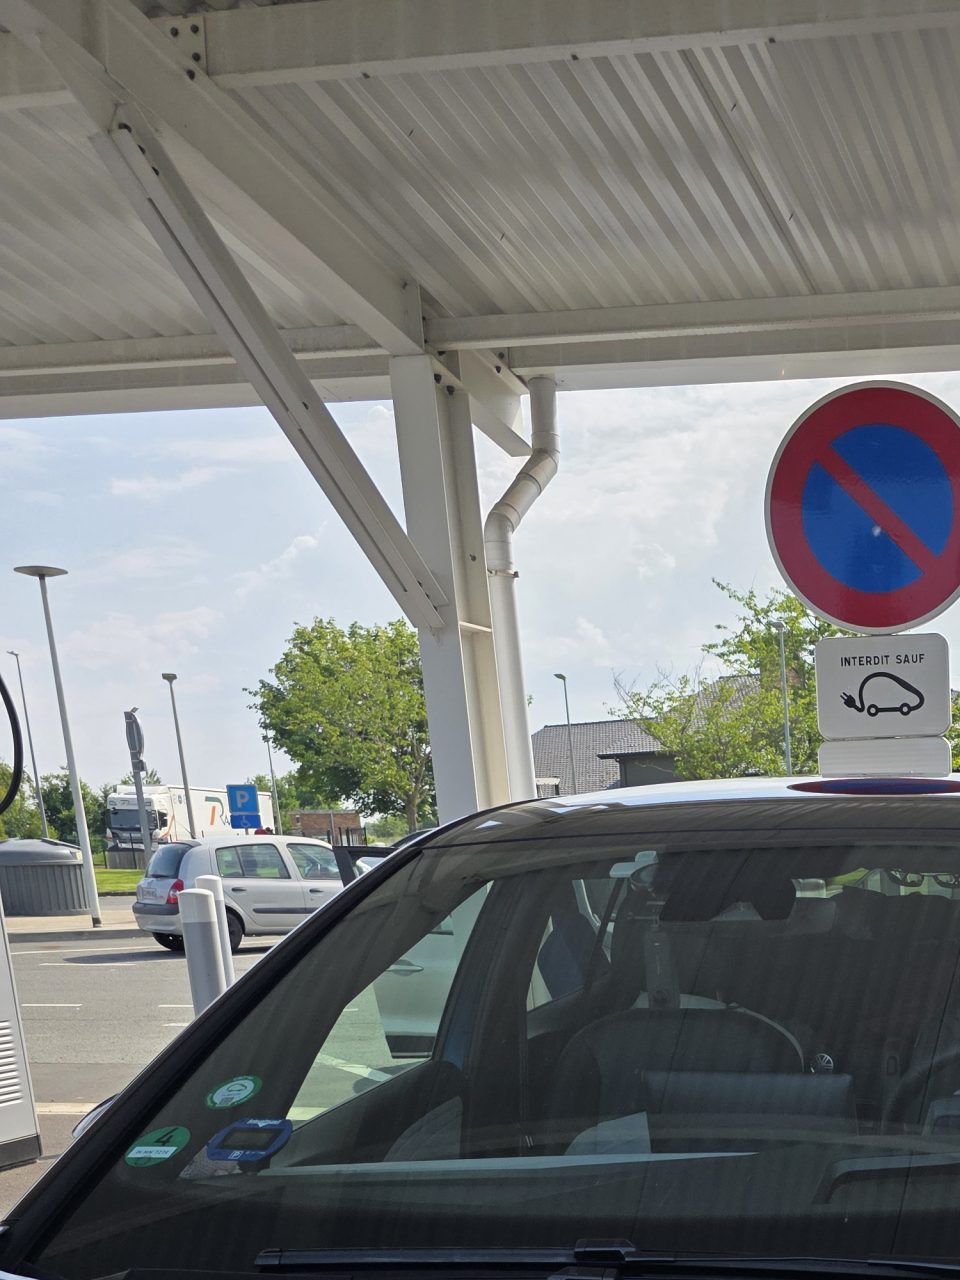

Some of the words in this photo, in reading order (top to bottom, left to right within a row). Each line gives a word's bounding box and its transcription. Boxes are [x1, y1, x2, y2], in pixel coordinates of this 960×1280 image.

[840, 655, 890, 667] INTERDIT
[896, 653, 925, 665] SAUF
[236, 790, 249, 808] P
[153, 1127, 179, 1146] 4
